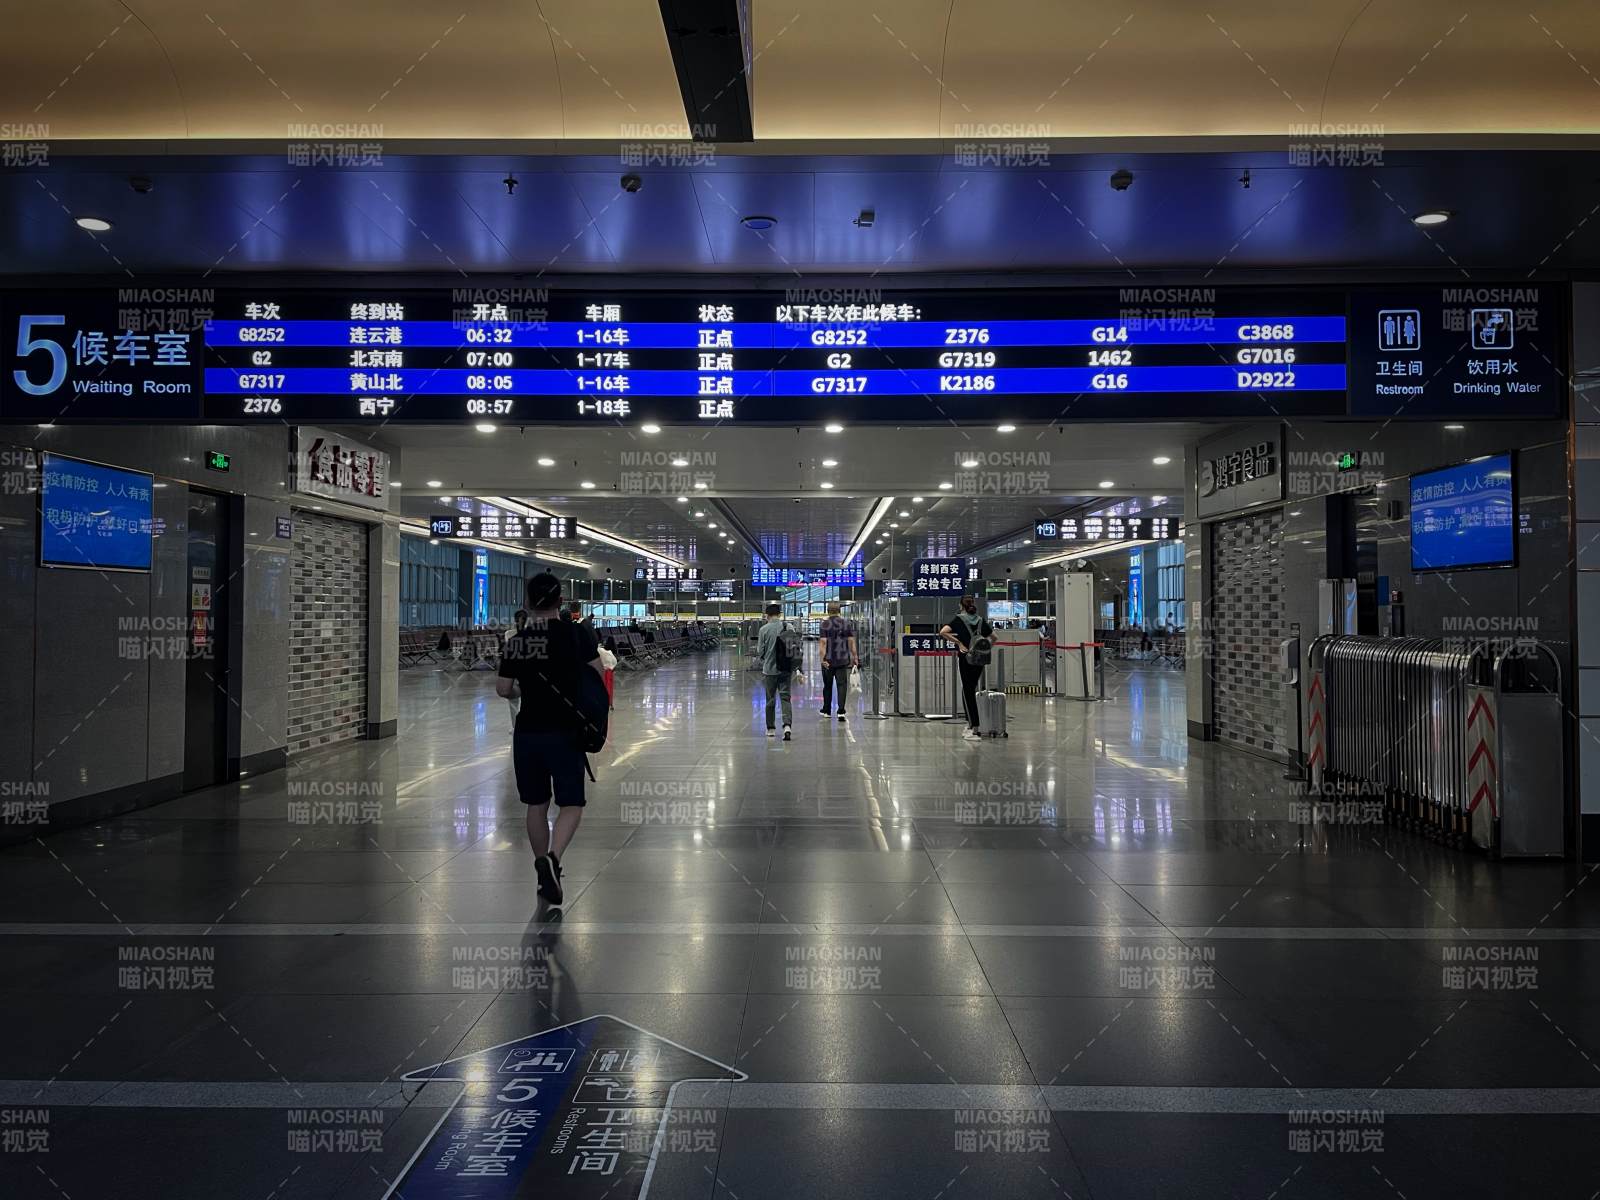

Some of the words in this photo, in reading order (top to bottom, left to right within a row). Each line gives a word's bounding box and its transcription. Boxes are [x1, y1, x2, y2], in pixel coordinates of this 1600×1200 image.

[245, 303, 280, 320] 车次
[350, 303, 403, 320] 终到站
[472, 304, 508, 320] 开点
[585, 304, 621, 322] 车厢
[699, 305, 734, 322] 状态
[239, 328, 284, 342] G8252
[350, 327, 403, 344] 连云港
[466, 329, 512, 343] 06:32
[577, 328, 630, 345] 1-16车
[698, 330, 733, 347] 正点
[811, 330, 867, 345] G8252
[945, 328, 989, 344] Z376
[1092, 327, 1127, 342] G14
[1238, 325, 1294, 340] C3868
[13, 315, 67, 395] 5
[72, 330, 190, 366] 候车室
[252, 351, 272, 365] G2
[350, 350, 403, 367] 北京南
[466, 352, 512, 366] 07:00
[577, 351, 630, 368] 1-17车
[698, 353, 733, 371] 正点
[827, 353, 851, 369] G2
[939, 352, 995, 368] G7319
[1088, 350, 1131, 366] 1462
[1237, 348, 1295, 364] G7016
[1376, 361, 1423, 376] 卫生间
[1467, 359, 1519, 375] 饮用水
[72, 380, 132, 396] Waiting
[143, 381, 191, 393] Room
[239, 375, 285, 389] G7317
[350, 373, 403, 390] 黄山北
[466, 376, 512, 390] 08:05
[577, 375, 630, 392] 1-16车
[699, 376, 733, 394] 正点
[811, 377, 867, 392] G7317
[940, 375, 995, 391] K2186
[1092, 374, 1128, 389] G16
[1238, 372, 1295, 387] D2922
[1376, 384, 1424, 395] Restroom
[1453, 382, 1500, 396] Drinking
[1507, 382, 1541, 393] Water
[243, 399, 281, 413] Z376
[359, 397, 394, 415] 西宁
[466, 399, 512, 414] 08:57
[577, 398, 631, 416] 1-18车
[699, 399, 734, 418] 正点
[47, 472, 99, 493] 疫情防控
[105, 480, 151, 502] 人人有责
[1413, 482, 1455, 502] 疫情防控
[920, 563, 959, 574] 终到西安
[917, 577, 963, 590] 安检专区
[496, 1077, 543, 1102] 5
[550, 1107, 587, 1155] Restrooms
[567, 1107, 633, 1175] 卫生间
[456, 1108, 541, 1177] 候车室
[434, 1141, 466, 1171] Room
